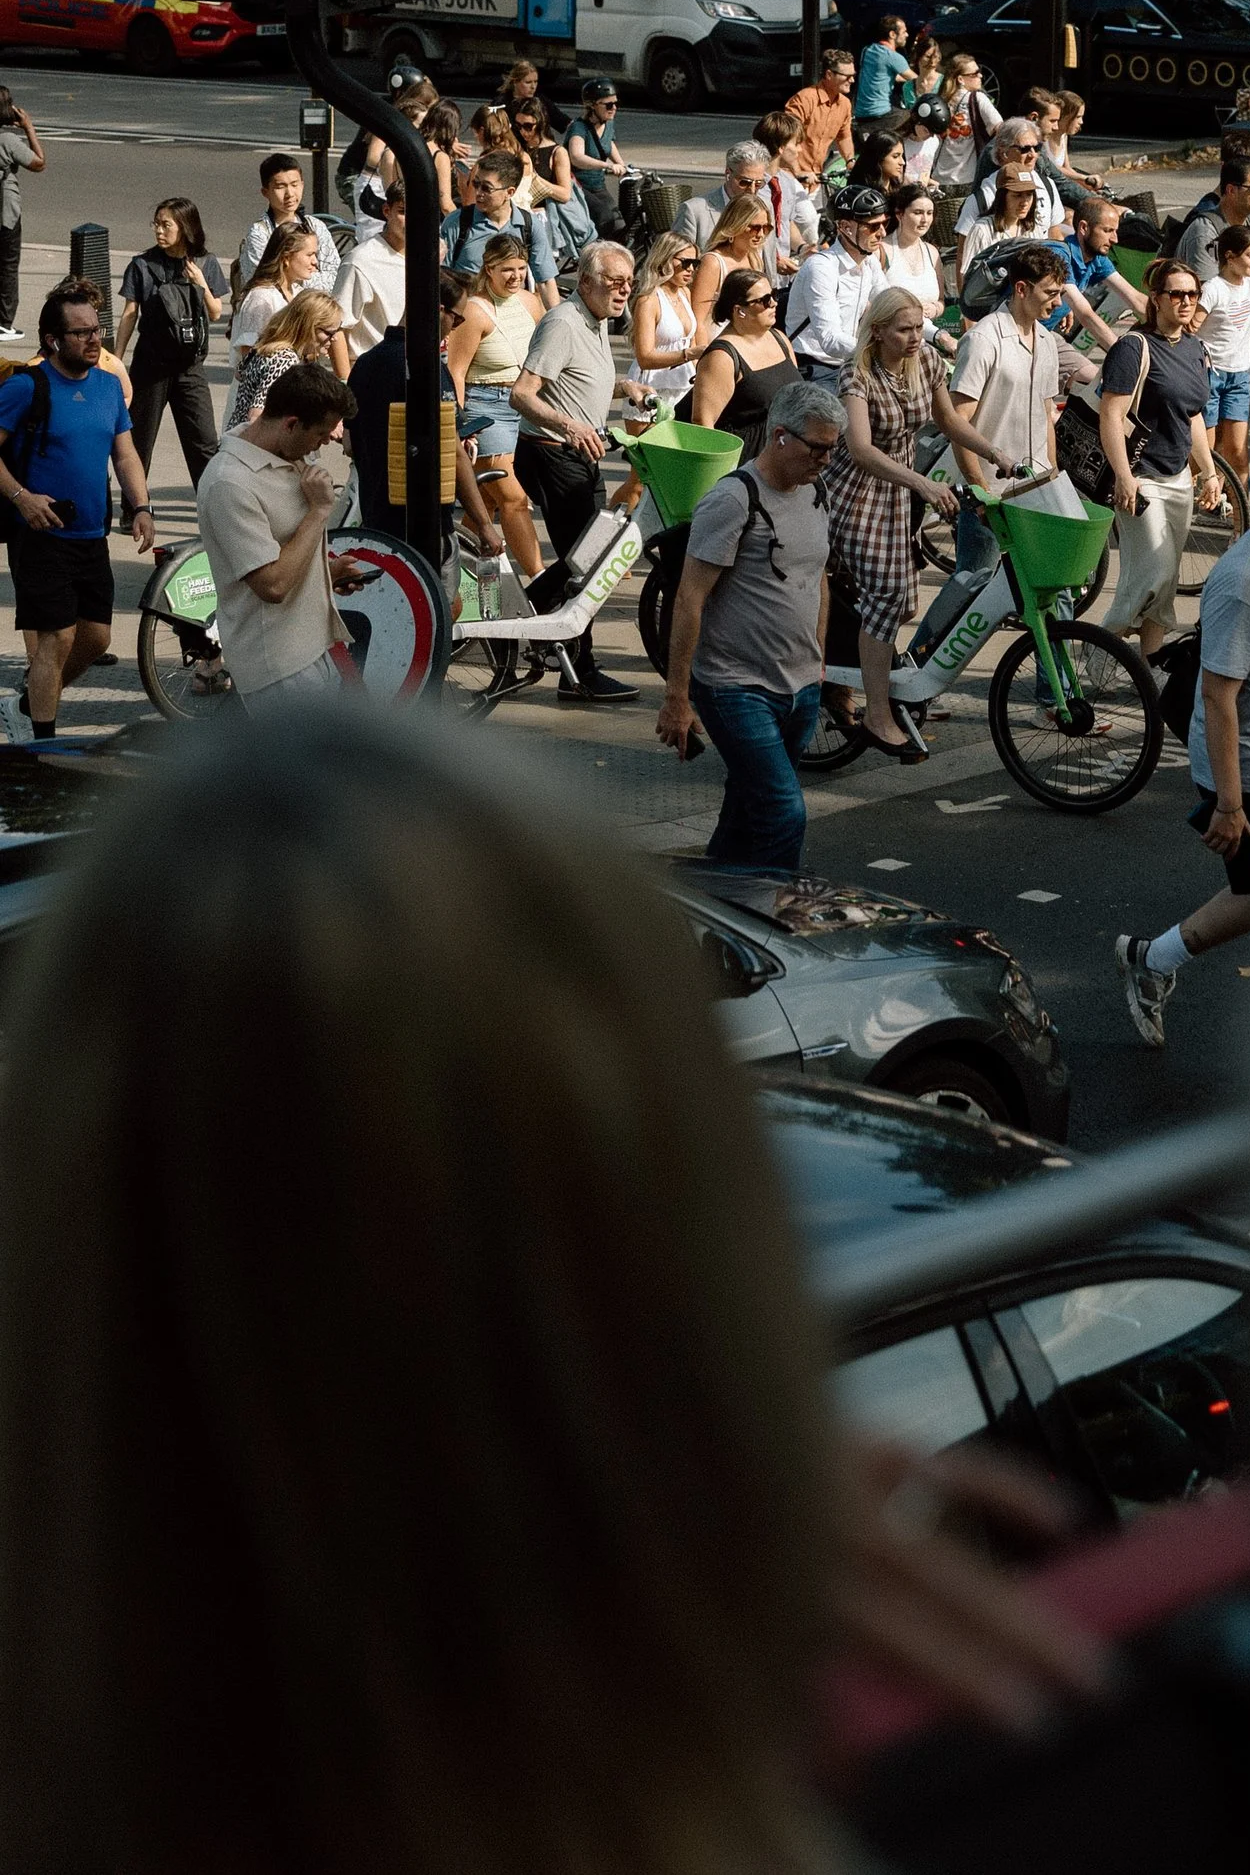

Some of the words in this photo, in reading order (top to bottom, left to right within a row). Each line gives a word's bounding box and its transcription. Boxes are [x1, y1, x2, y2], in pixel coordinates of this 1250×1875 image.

[188, 576, 211, 588] HAVE
[584, 540, 640, 603] Lime
[932, 611, 989, 670] Lime
